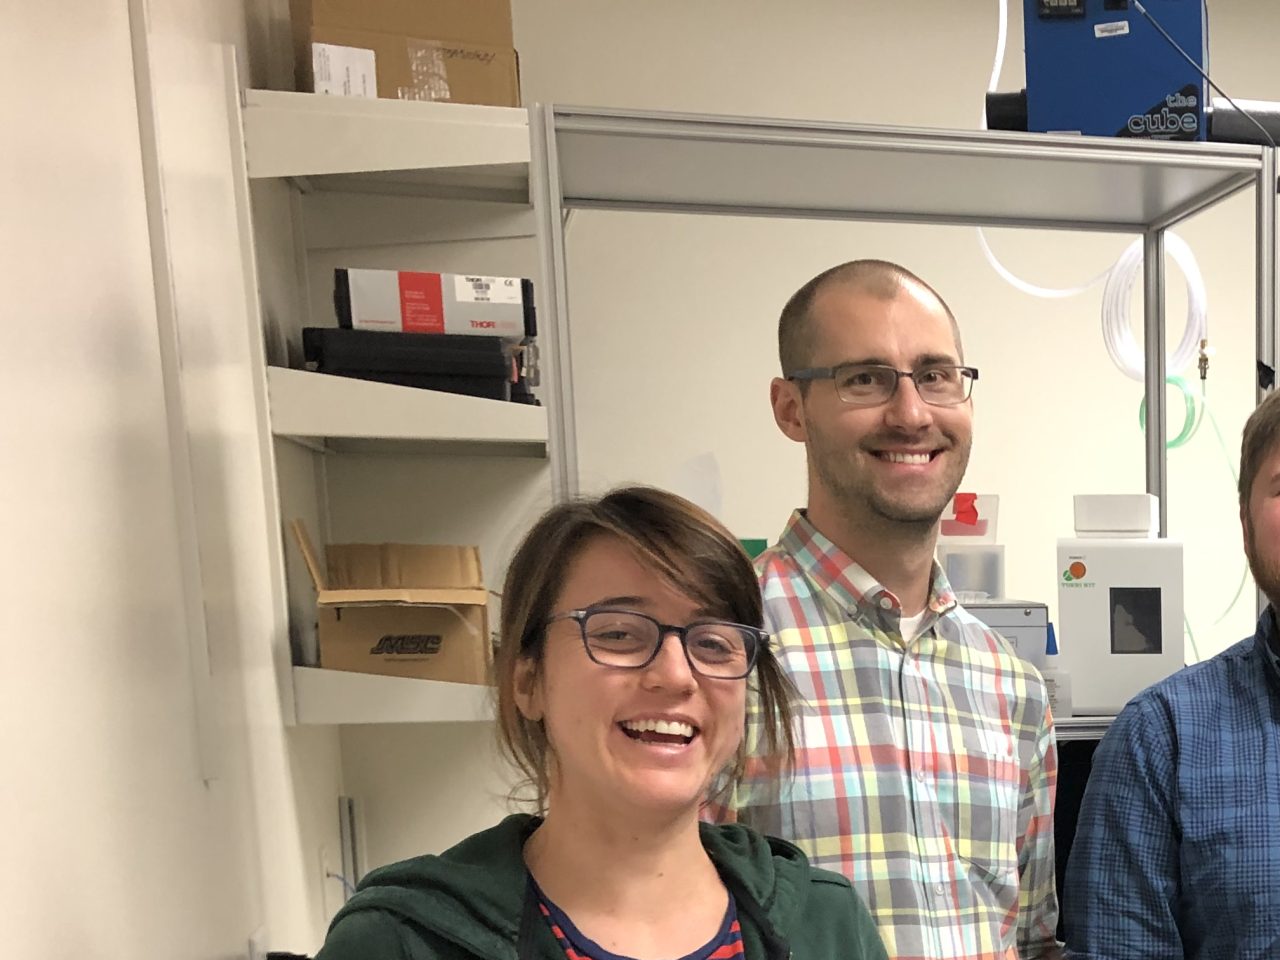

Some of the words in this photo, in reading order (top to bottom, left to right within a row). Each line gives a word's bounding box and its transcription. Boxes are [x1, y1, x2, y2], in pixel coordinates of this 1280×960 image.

[1166, 93, 1197, 107] the
[1128, 108, 1197, 133] cube
[470, 320, 517, 329] THOR
